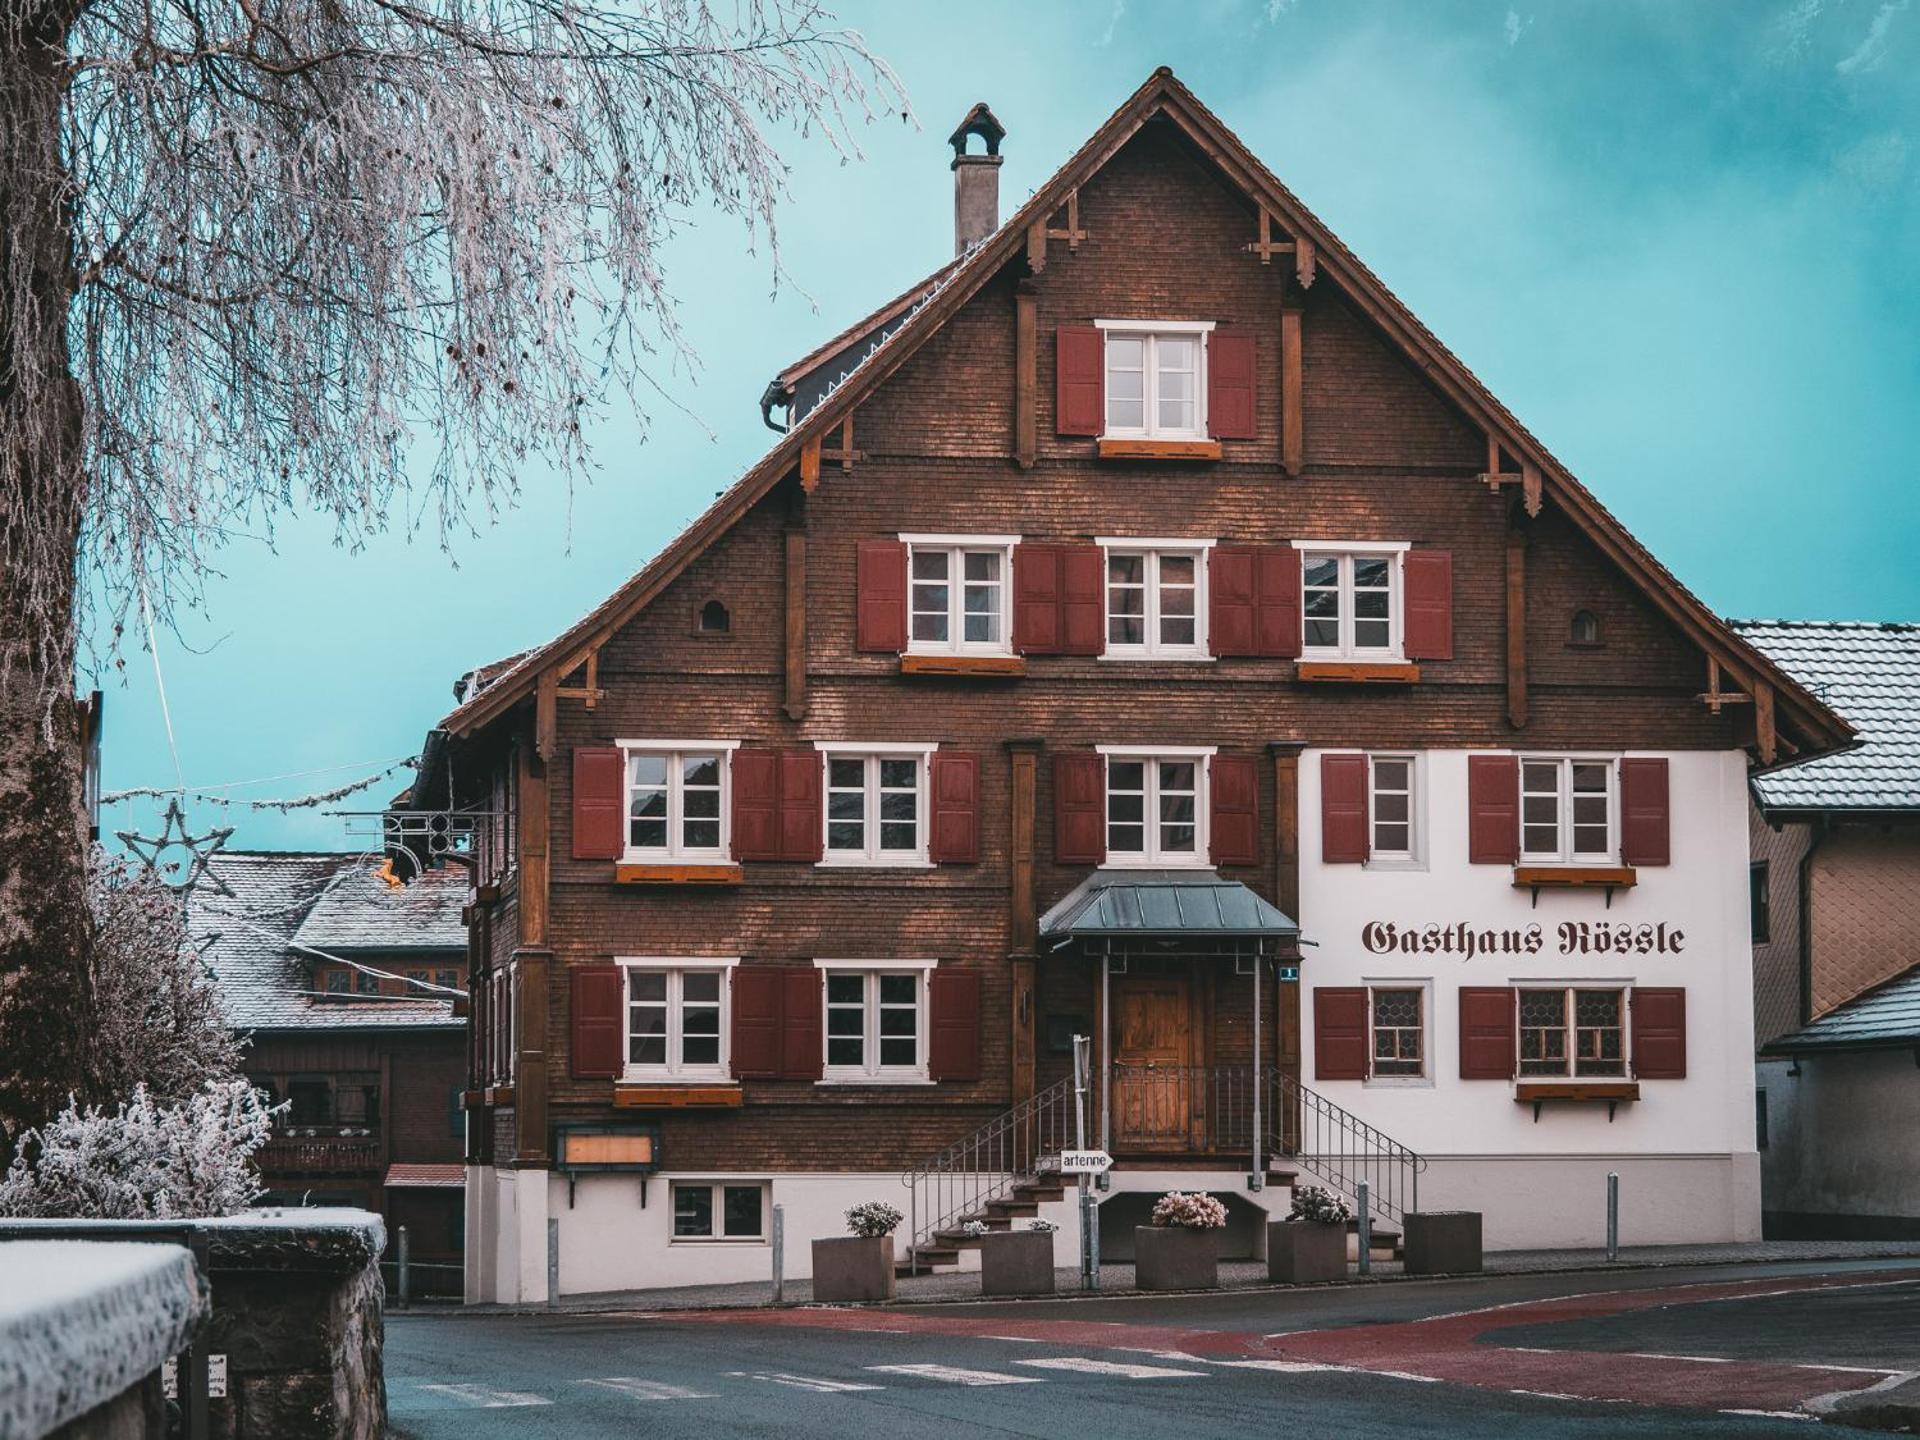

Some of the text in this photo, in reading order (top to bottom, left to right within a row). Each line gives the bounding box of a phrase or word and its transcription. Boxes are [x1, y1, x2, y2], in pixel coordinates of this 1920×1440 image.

[1361, 920, 1686, 963] Gasthaus Rössle
[1063, 1155, 1107, 1167] artenne
